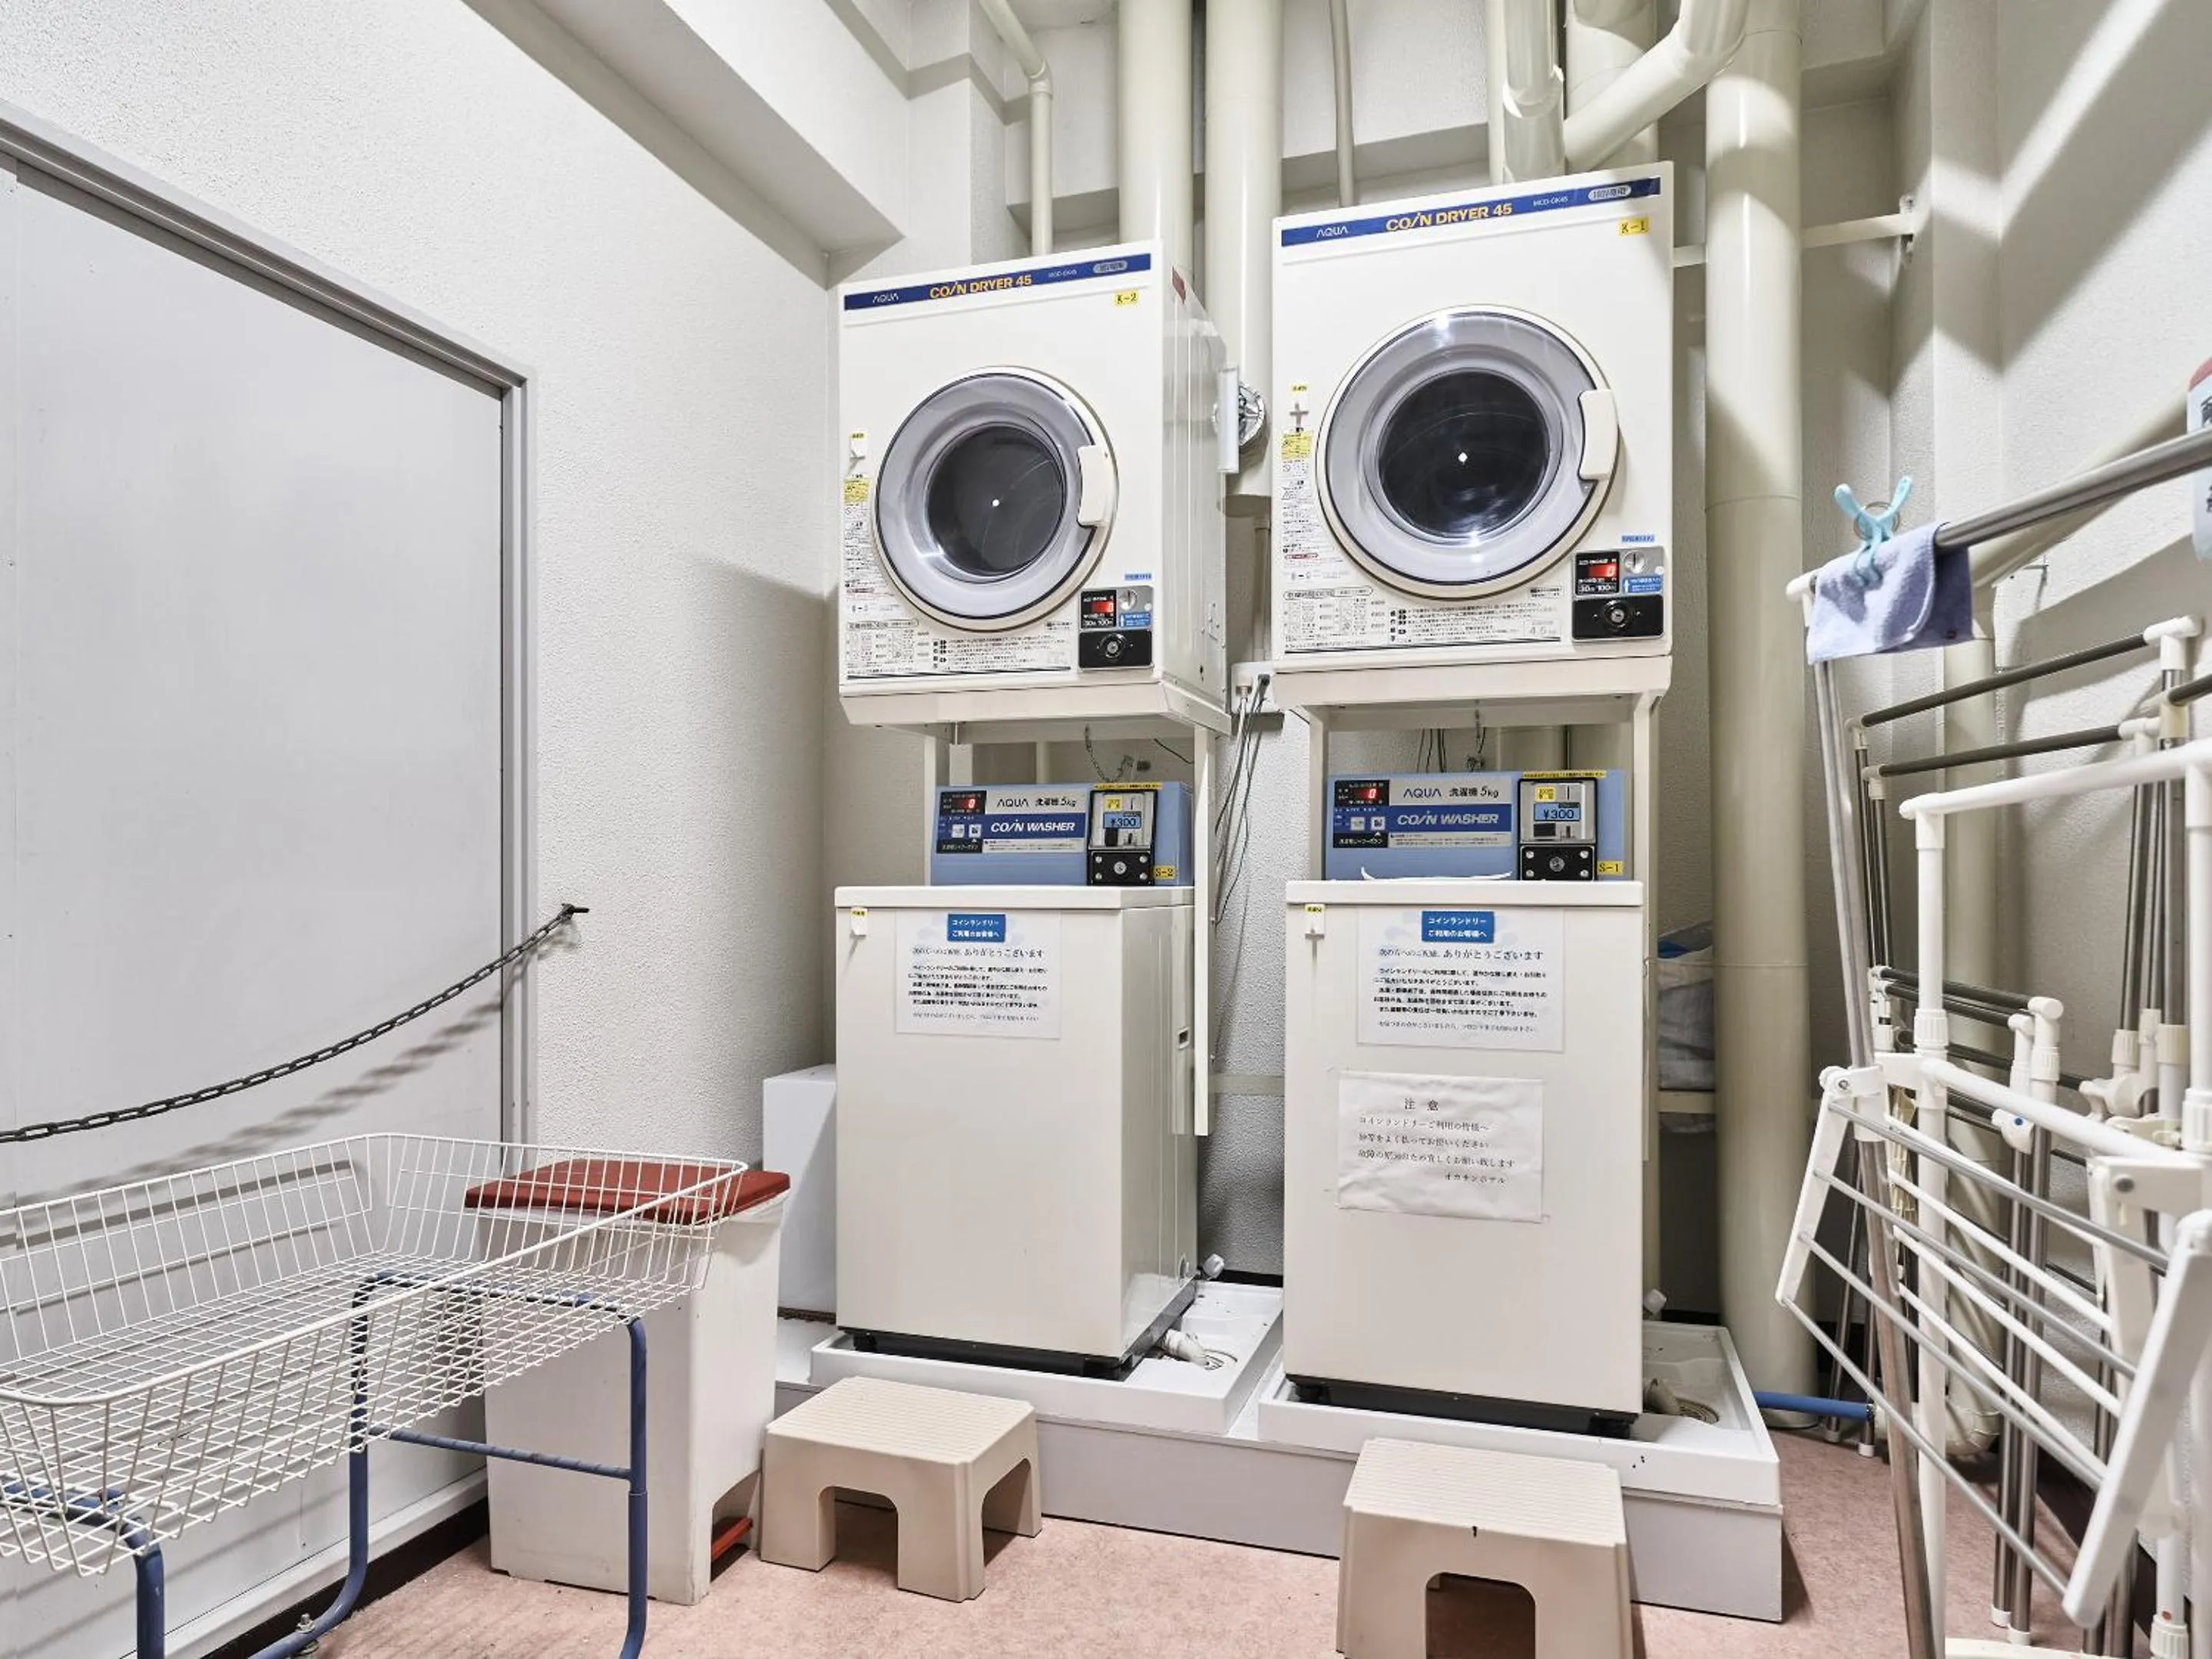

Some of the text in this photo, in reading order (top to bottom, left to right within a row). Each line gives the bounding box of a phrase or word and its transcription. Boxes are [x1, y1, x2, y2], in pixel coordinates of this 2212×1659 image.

[1435, 206, 1488, 224] DRYER
[1492, 203, 1512, 216] 45
[969, 277, 1013, 294] DRYER
[1015, 274, 1032, 286] 45
[1403, 788, 1442, 799] AQUA
[997, 798, 1029, 808] AQUA
[1440, 813, 1499, 825] WASHER
[1543, 809, 1575, 820] ¥300
[1027, 822, 1075, 833] WASHER
[1155, 868, 1174, 877] S-2
[1599, 863, 1619, 873] S-1
[1428, 917, 1488, 926] コインランドリー
